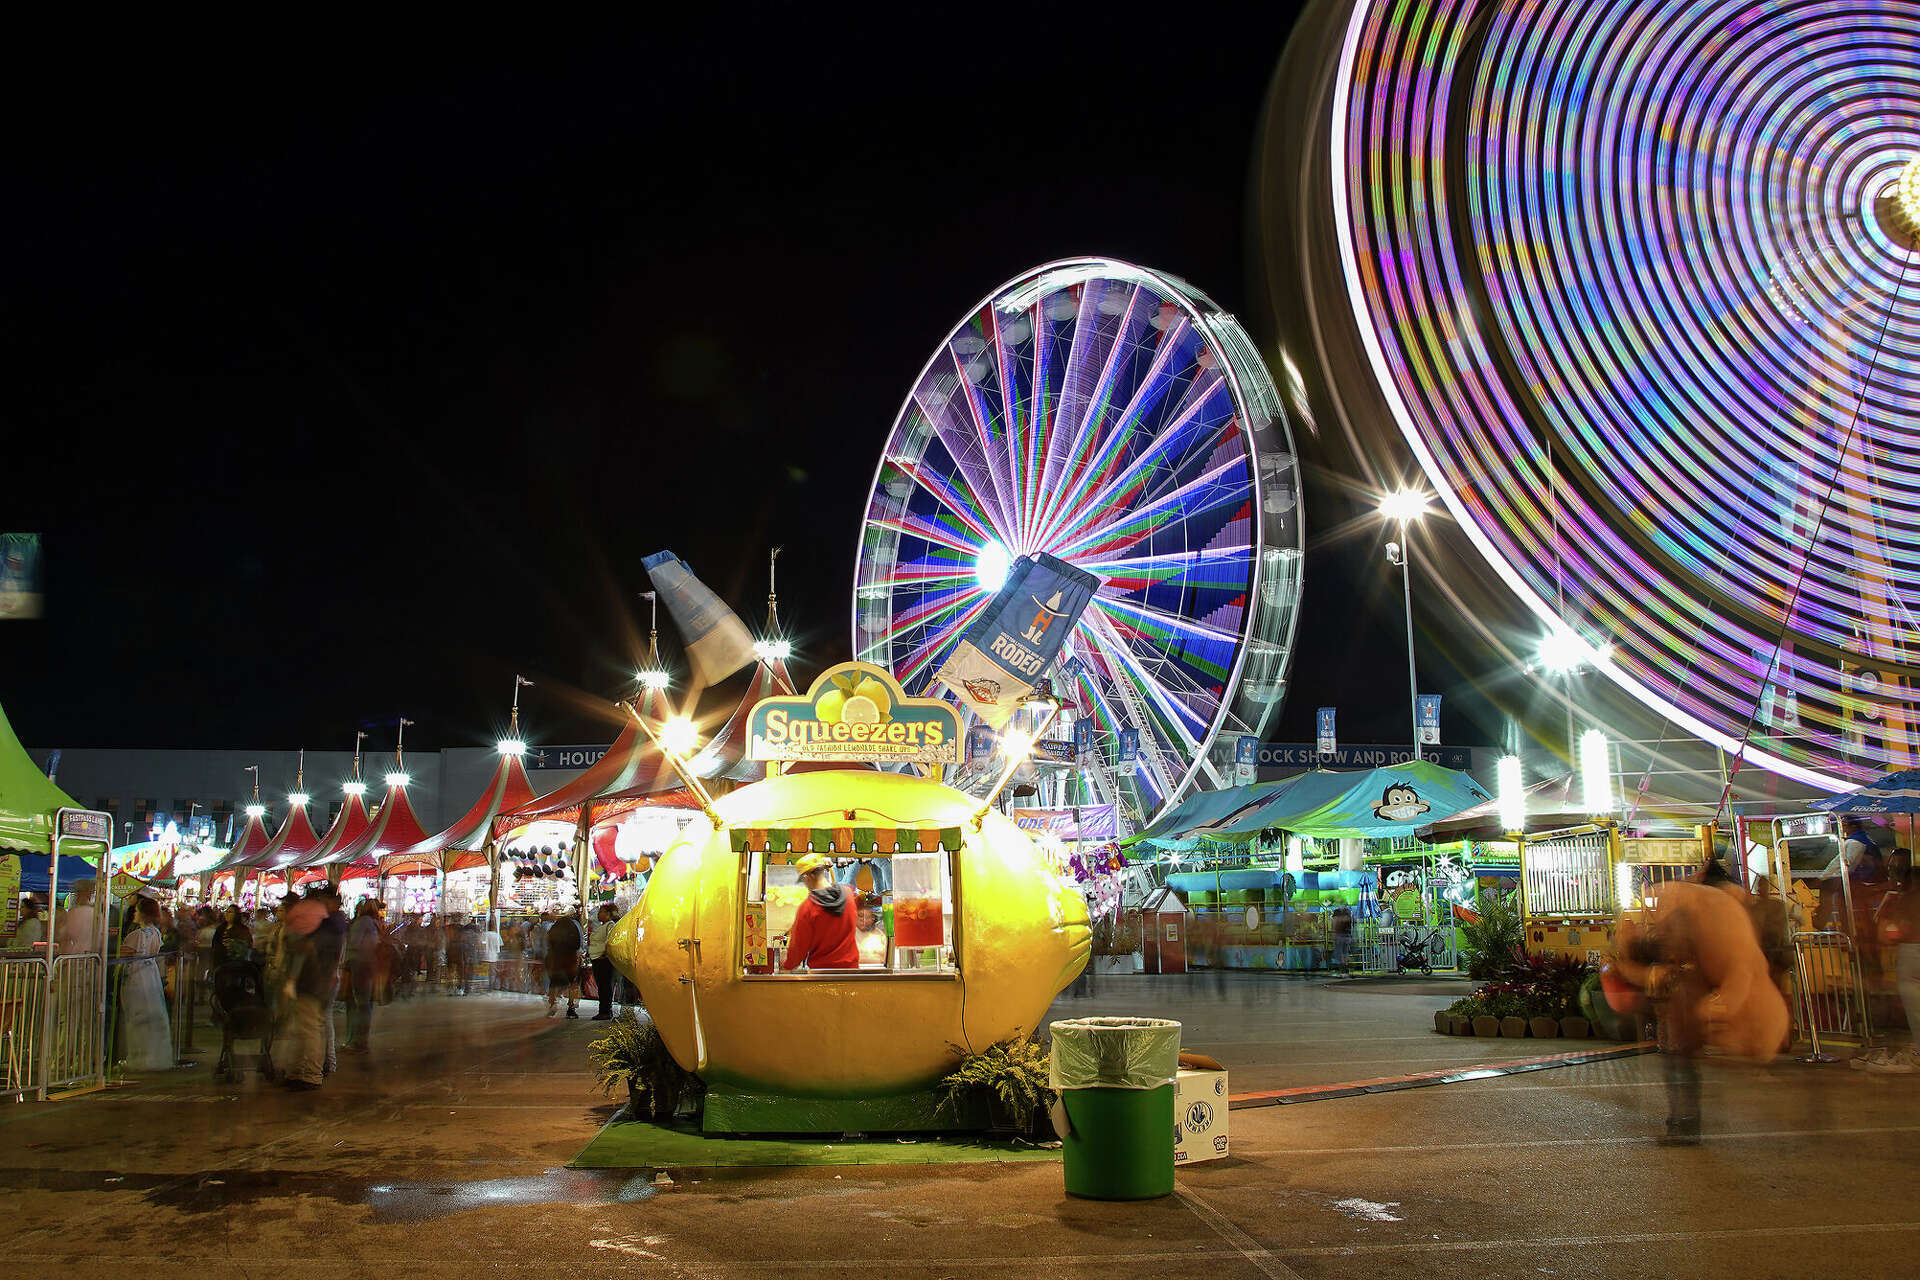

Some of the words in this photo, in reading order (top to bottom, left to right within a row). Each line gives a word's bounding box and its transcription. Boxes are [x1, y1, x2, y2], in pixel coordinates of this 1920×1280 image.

[990, 635, 1042, 676] RODEO
[766, 709, 943, 745] Squeezers
[843, 743, 877, 752] LEMONADE
[878, 745, 897, 753] SHAKE
[1299, 750, 1348, 764] SHOW
[1353, 750, 1386, 764] AND
[1624, 842, 1697, 858] ENTER
